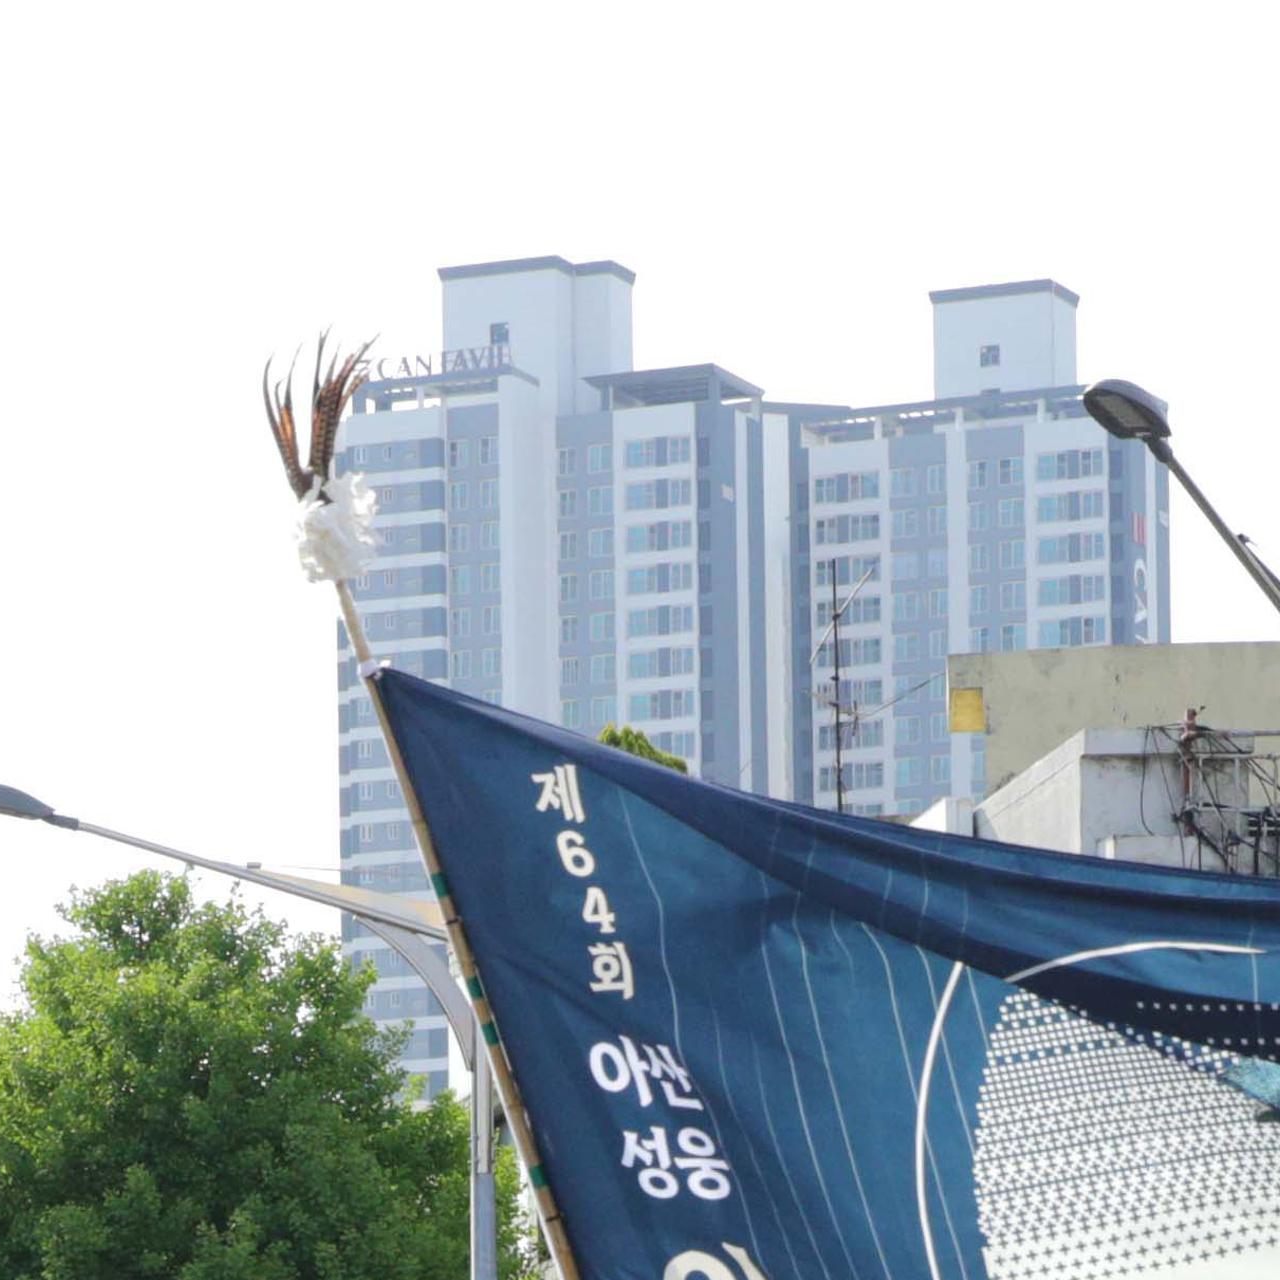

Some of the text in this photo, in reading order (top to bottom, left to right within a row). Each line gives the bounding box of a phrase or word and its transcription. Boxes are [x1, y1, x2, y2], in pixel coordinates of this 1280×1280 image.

[531, 764, 634, 1000] 제64회
[589, 1034, 704, 1110] 아산
[621, 1125, 730, 1200] 성웅
